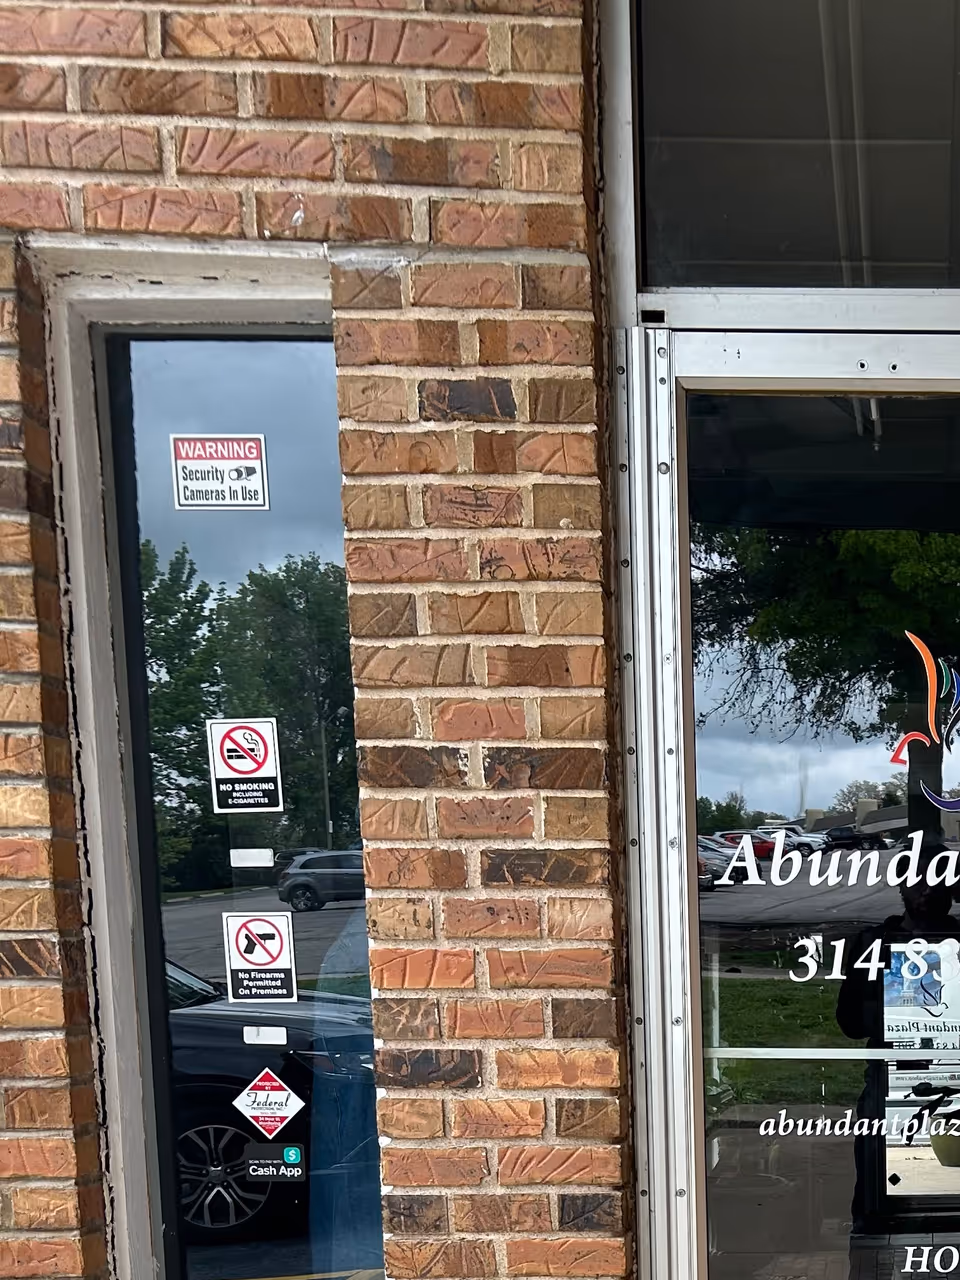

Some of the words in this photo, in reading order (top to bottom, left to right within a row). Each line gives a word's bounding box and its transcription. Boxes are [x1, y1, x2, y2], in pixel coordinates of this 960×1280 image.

[178, 441, 257, 459] WARNING
[182, 465, 225, 484] Security
[183, 485, 226, 502] Cameras
[229, 485, 239, 501] In
[241, 485, 259, 501] Use
[219, 783, 233, 791] NO
[234, 782, 275, 791] SMOKING
[788, 938, 885, 983] 314
[250, 971, 285, 979] Firearms
[243, 979, 281, 987] Permitted
[246, 1092, 290, 1107] Federal
[249, 1165, 277, 1175] Cash
[279, 1165, 302, 1177] App
